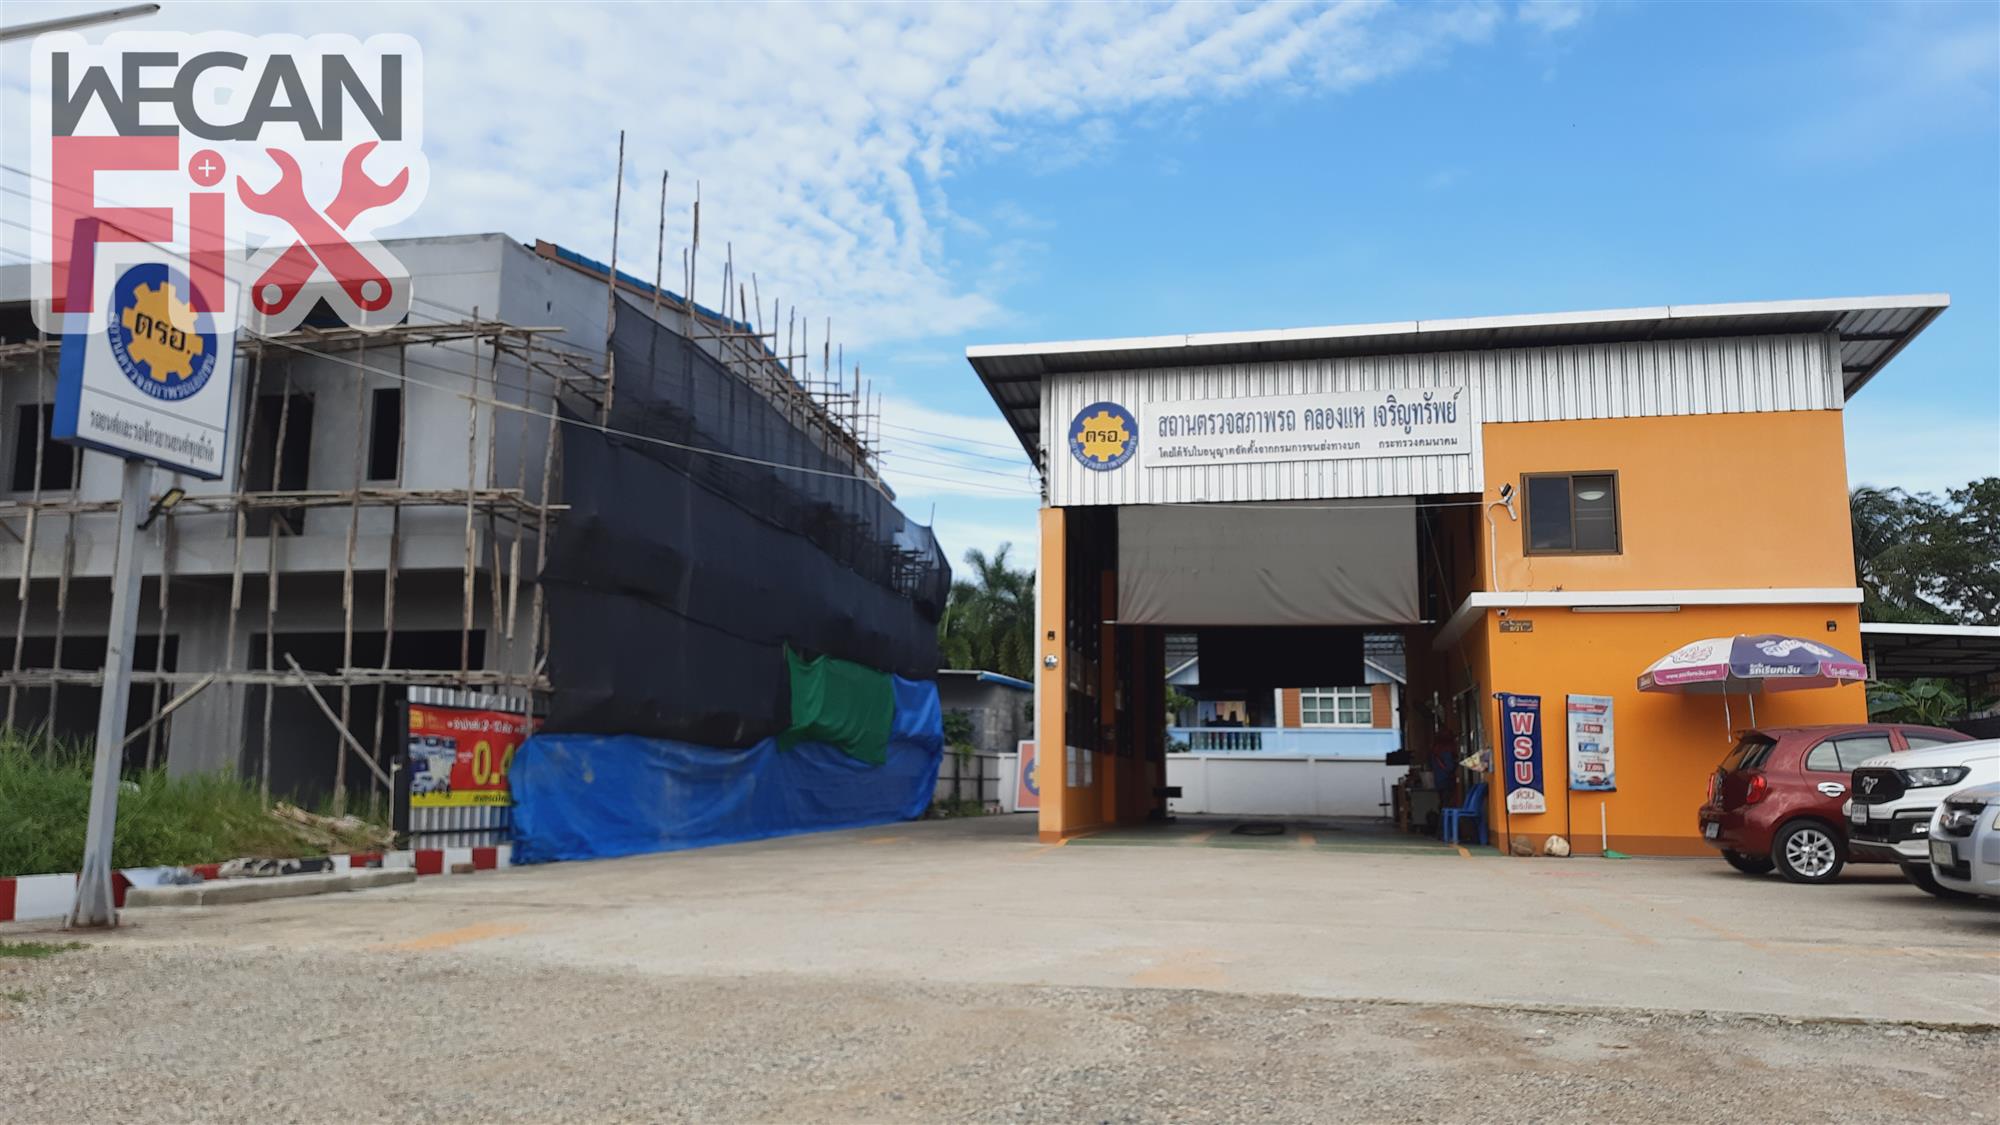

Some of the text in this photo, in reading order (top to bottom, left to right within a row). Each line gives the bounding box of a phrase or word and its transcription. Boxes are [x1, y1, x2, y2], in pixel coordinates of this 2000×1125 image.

[1158, 387, 1464, 437] สถานตรวจสภาพรถ คลองแห เจริญทรัพย์
